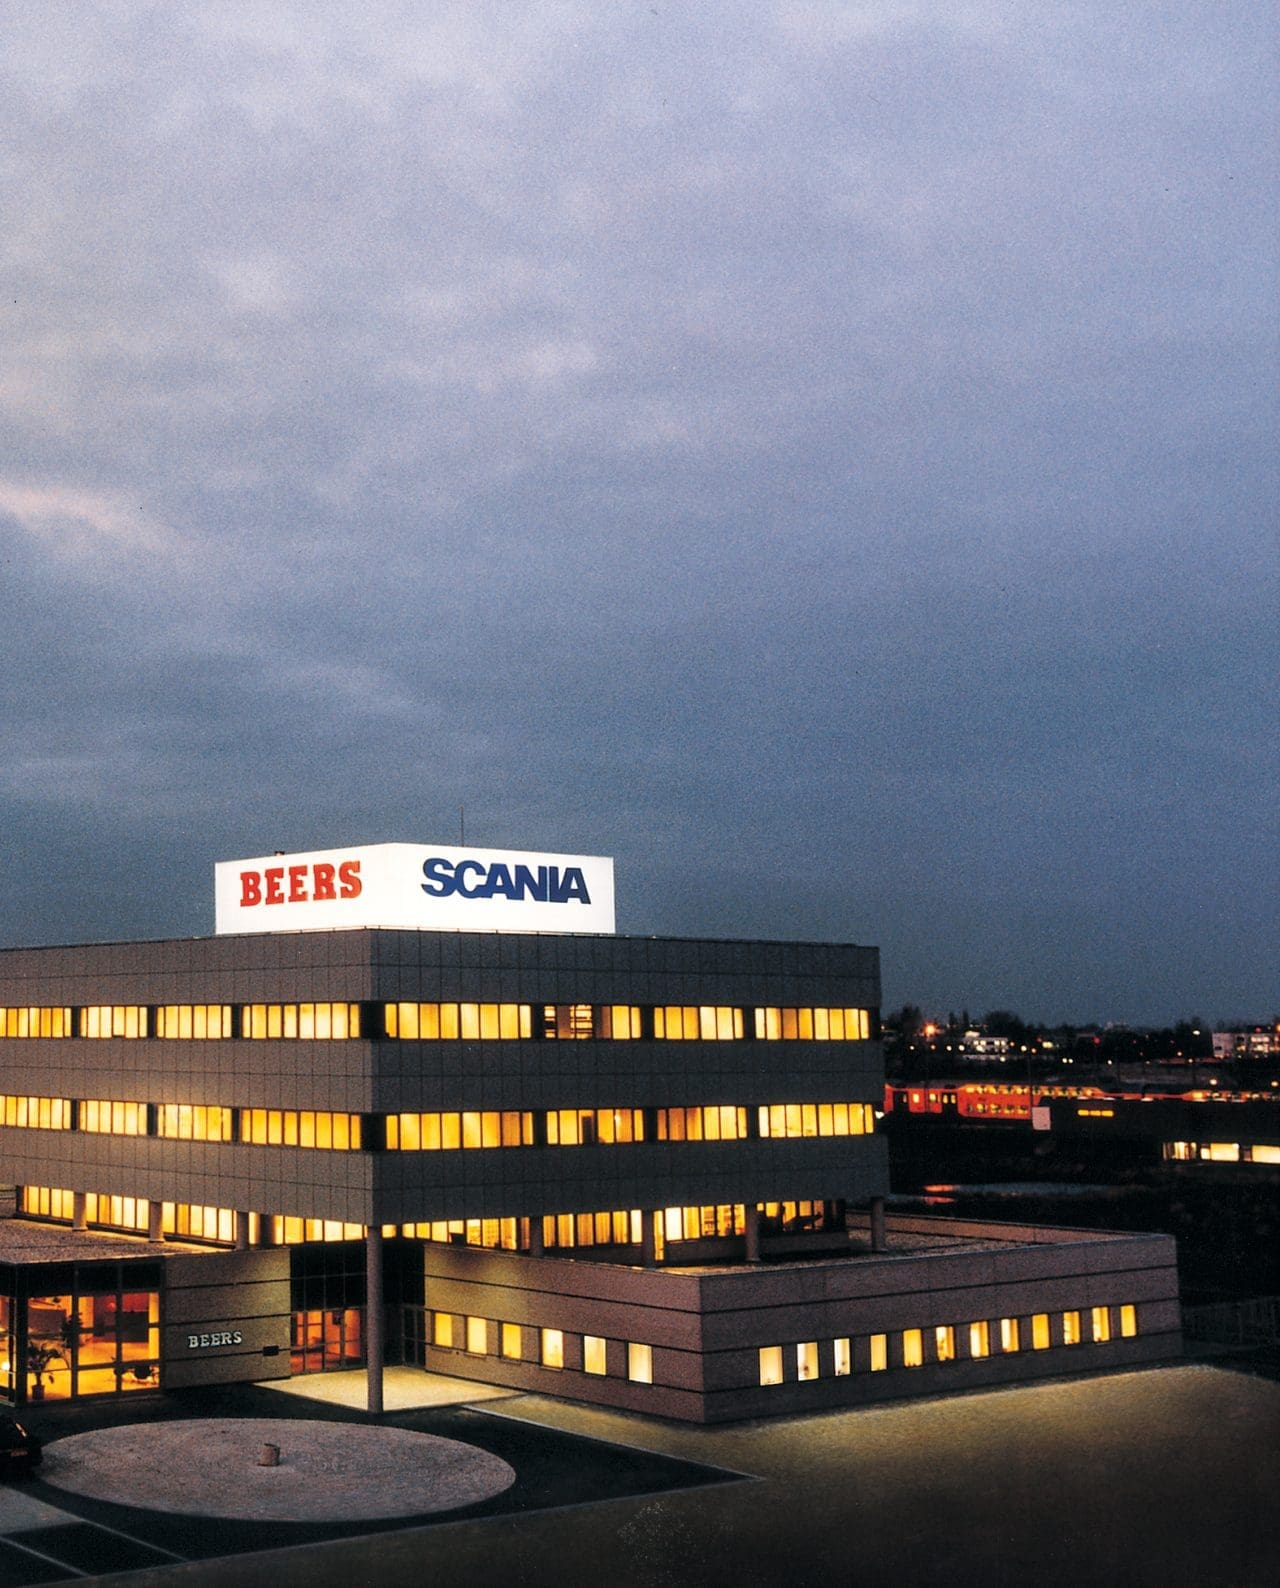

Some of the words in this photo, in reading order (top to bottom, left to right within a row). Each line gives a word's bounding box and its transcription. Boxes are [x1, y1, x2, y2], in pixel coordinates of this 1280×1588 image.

[240, 860, 362, 907] BEERS
[421, 858, 591, 904] SCANIA
[189, 1332, 242, 1348] BEERS
